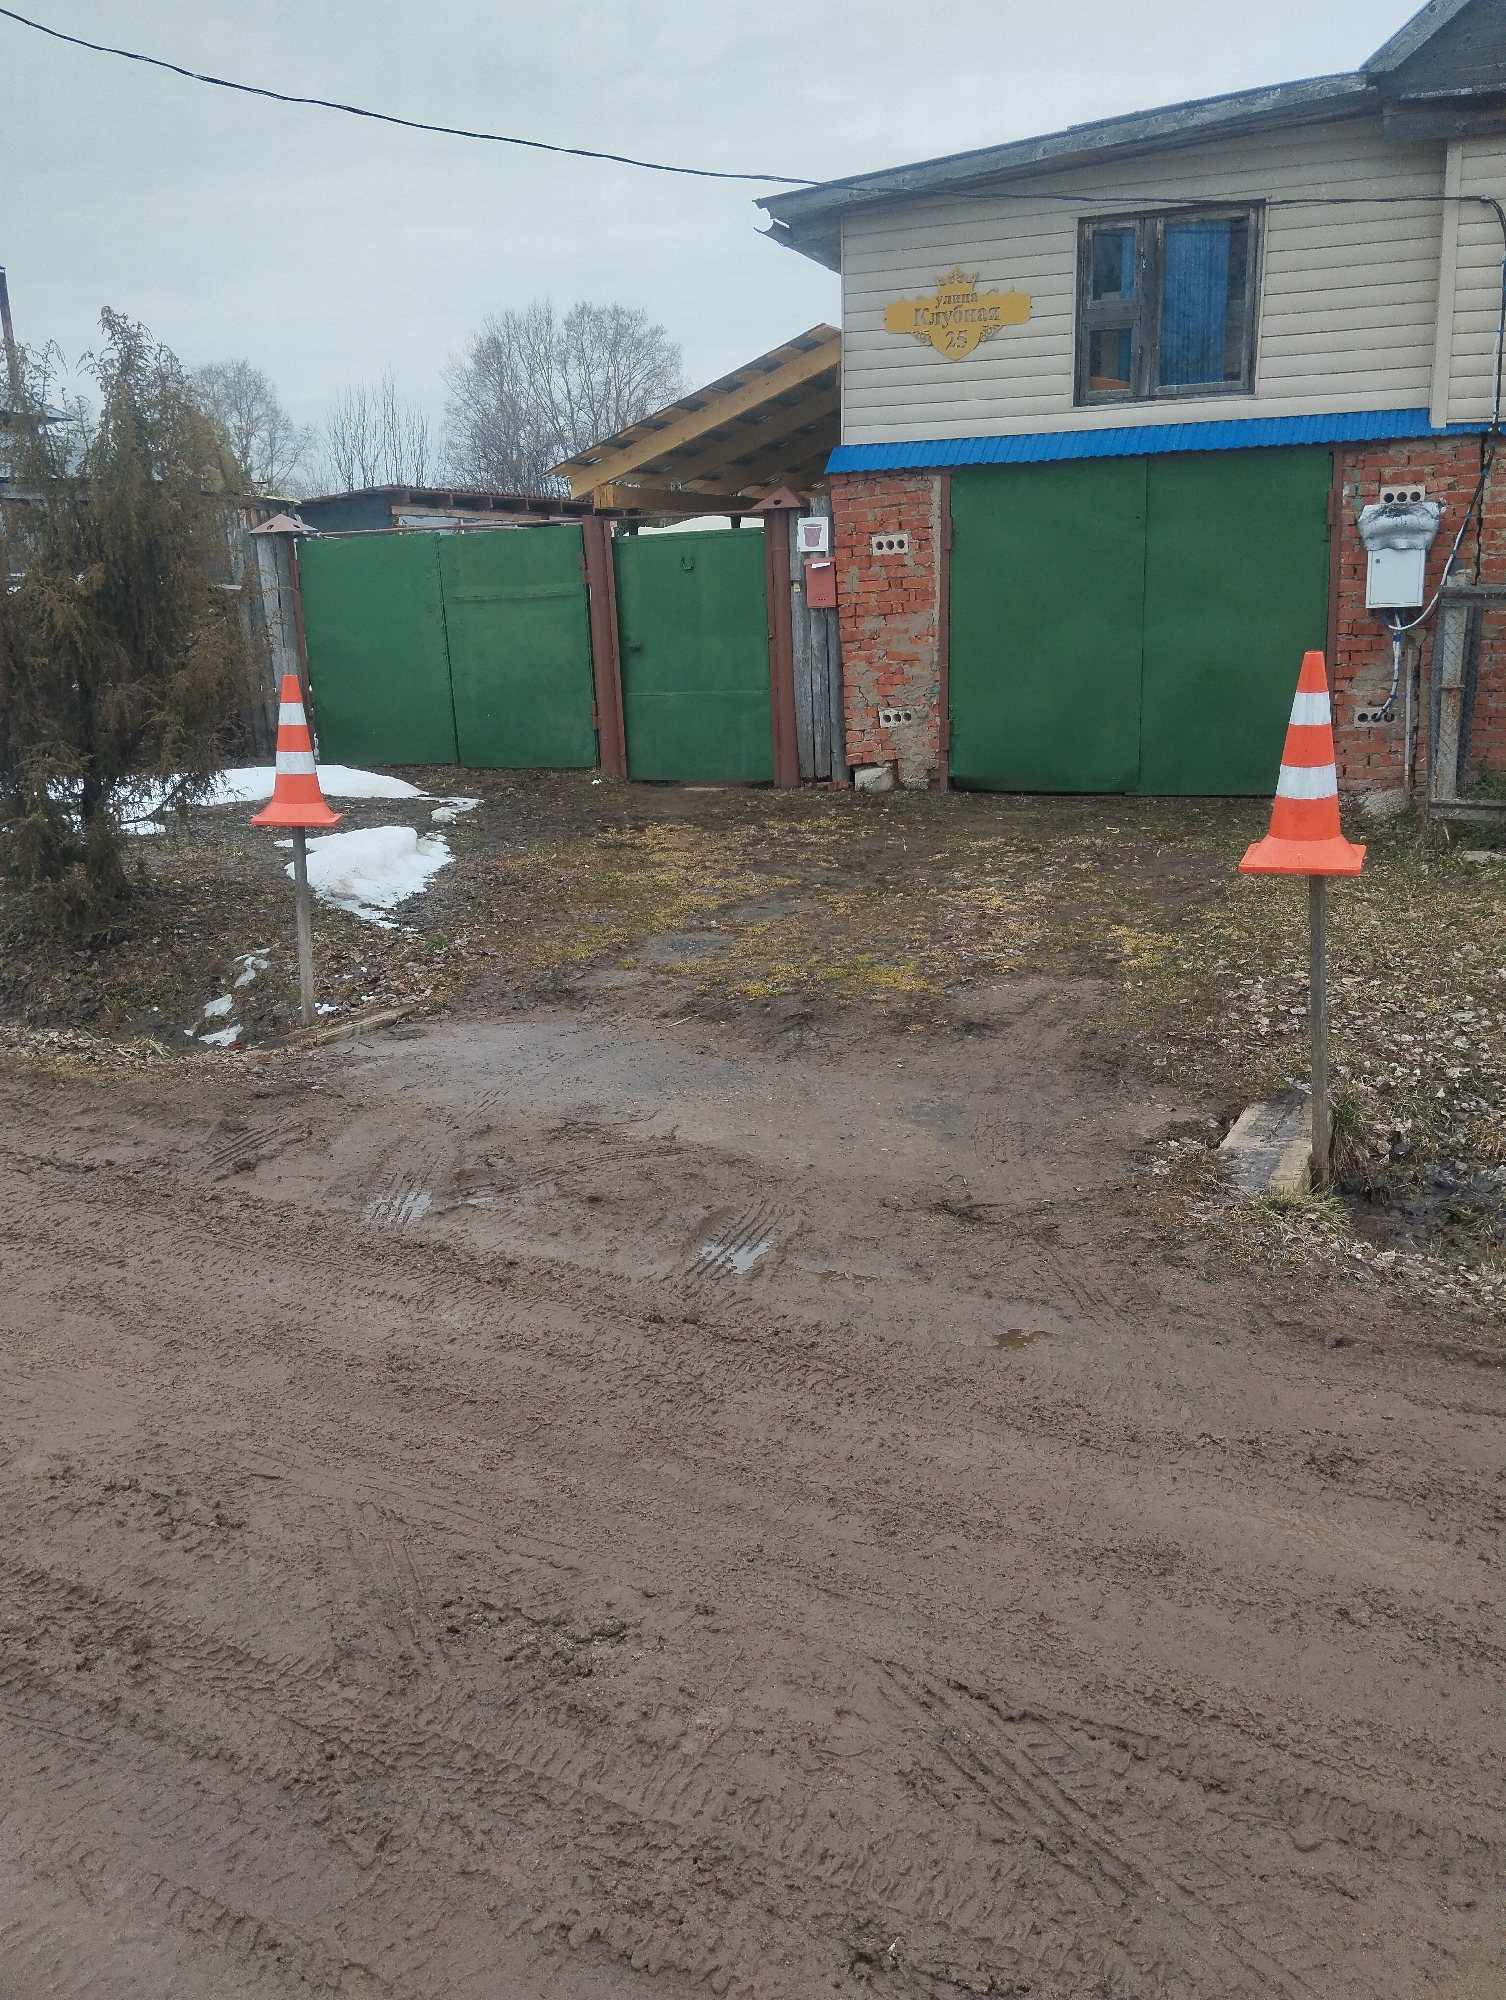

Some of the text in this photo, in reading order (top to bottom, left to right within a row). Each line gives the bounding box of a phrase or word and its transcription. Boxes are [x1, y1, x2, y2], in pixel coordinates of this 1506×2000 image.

[935, 292, 978, 309] улица
[913, 304, 1001, 329] Клубная
[945, 330, 968, 350] 25
